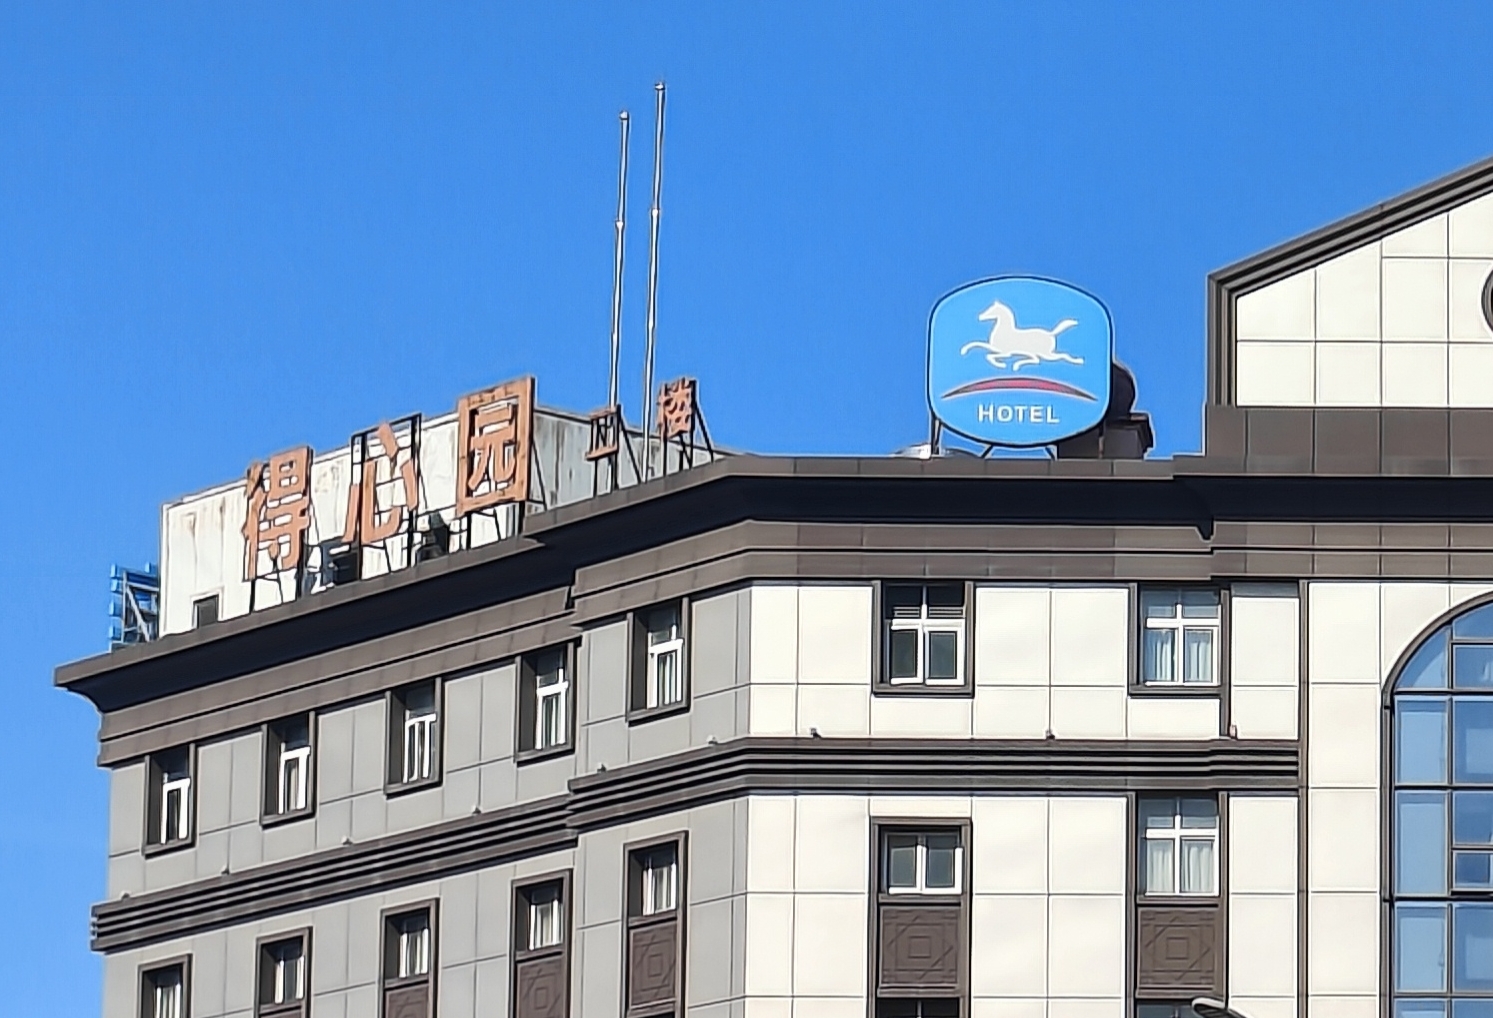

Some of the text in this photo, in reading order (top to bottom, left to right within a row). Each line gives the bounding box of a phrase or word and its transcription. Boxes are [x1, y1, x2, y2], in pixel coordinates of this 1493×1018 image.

[977, 402, 1060, 425] HOTEL
[240, 376, 535, 582] 得心园
